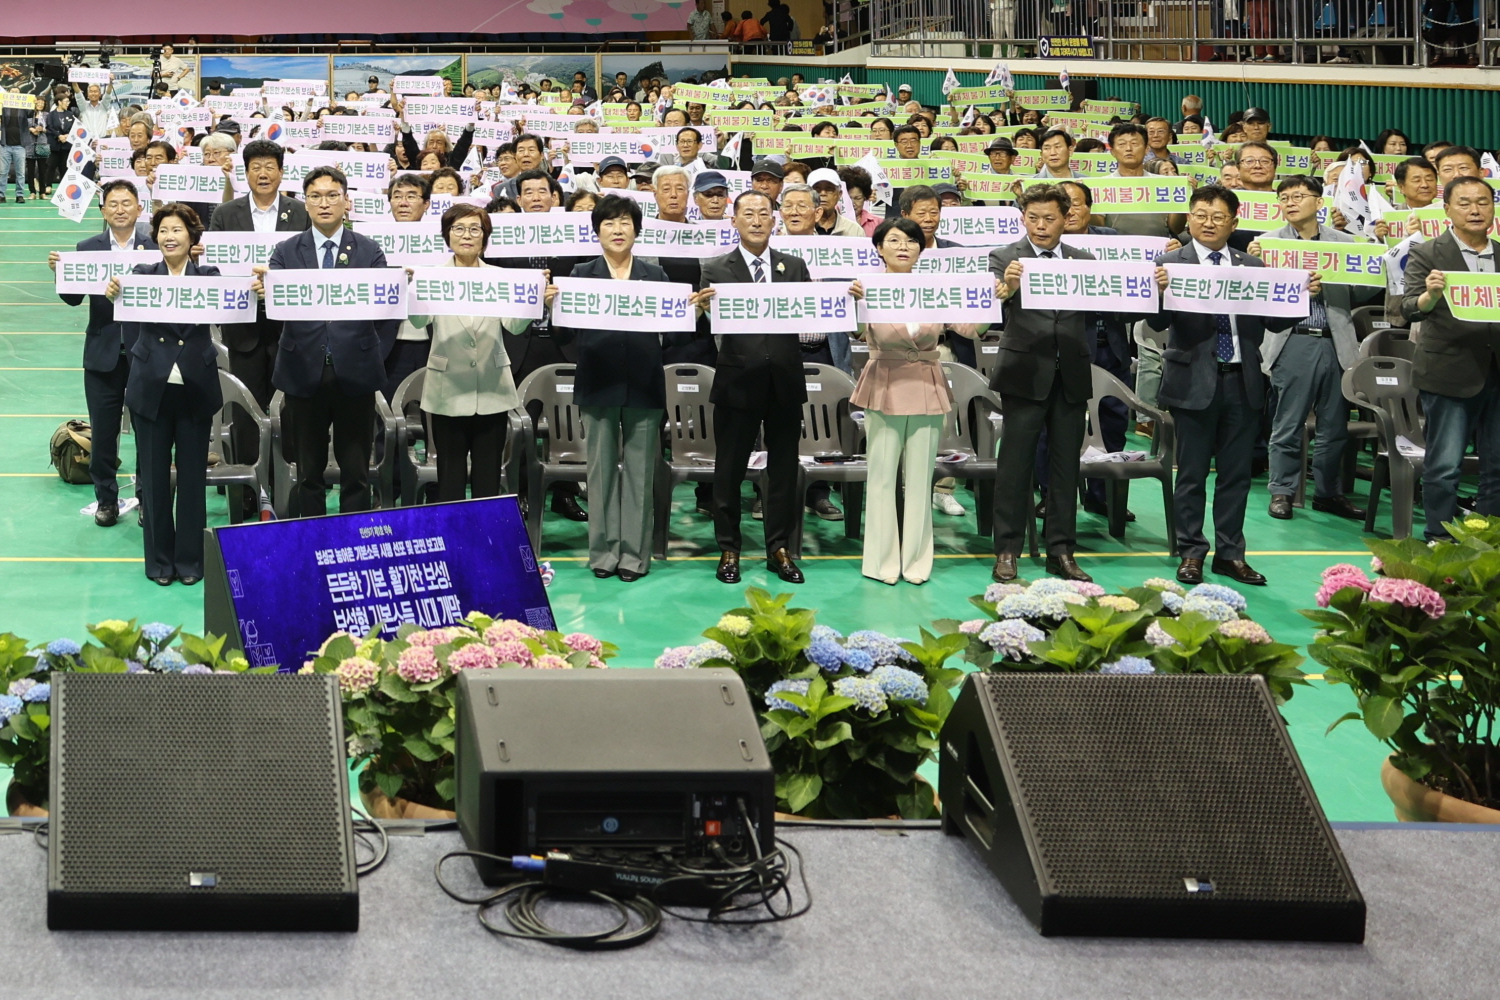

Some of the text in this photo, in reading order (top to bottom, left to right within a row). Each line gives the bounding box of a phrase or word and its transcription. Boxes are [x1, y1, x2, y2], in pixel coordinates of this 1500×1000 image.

[951, 89, 1006, 104] 대체불가 보성
[1016, 94, 1066, 104] 대체불가 보성
[408, 104, 473, 116] 든든한 기본소득 보성
[324, 122, 391, 136] 든든한 기본소득 보성
[714, 116, 769, 127] 대체불가 보성
[1156, 187, 1186, 202] 보성
[953, 218, 1019, 234] 기본소득 보성
[1262, 250, 1382, 274] 대체불가 보성
[273, 284, 399, 305] 든든한 기본소득 보성
[416, 280, 538, 305] 든든한 기본소득 보성
[1029, 273, 1151, 298] 든든한 기본소득 보성
[1170, 278, 1300, 303] 든든한 기본소득 보성
[121, 284, 249, 309] 든든한 기본소득 보성
[561, 292, 687, 318] 든든한 기본소득 보성
[865, 288, 991, 309] 든든한 기본소득 보성
[719, 297, 846, 318] 든든한 기본소득 보성
[315, 536, 446, 565] 보성군 농어촌 기본소득 시행 선포 및 군민 보고회
[326, 561, 452, 603] 든든한 기본, 활기찬 보성!
[333, 606, 370, 636] 보성형
[416, 597, 441, 627] 시대
[437, 594, 463, 624] 개막
